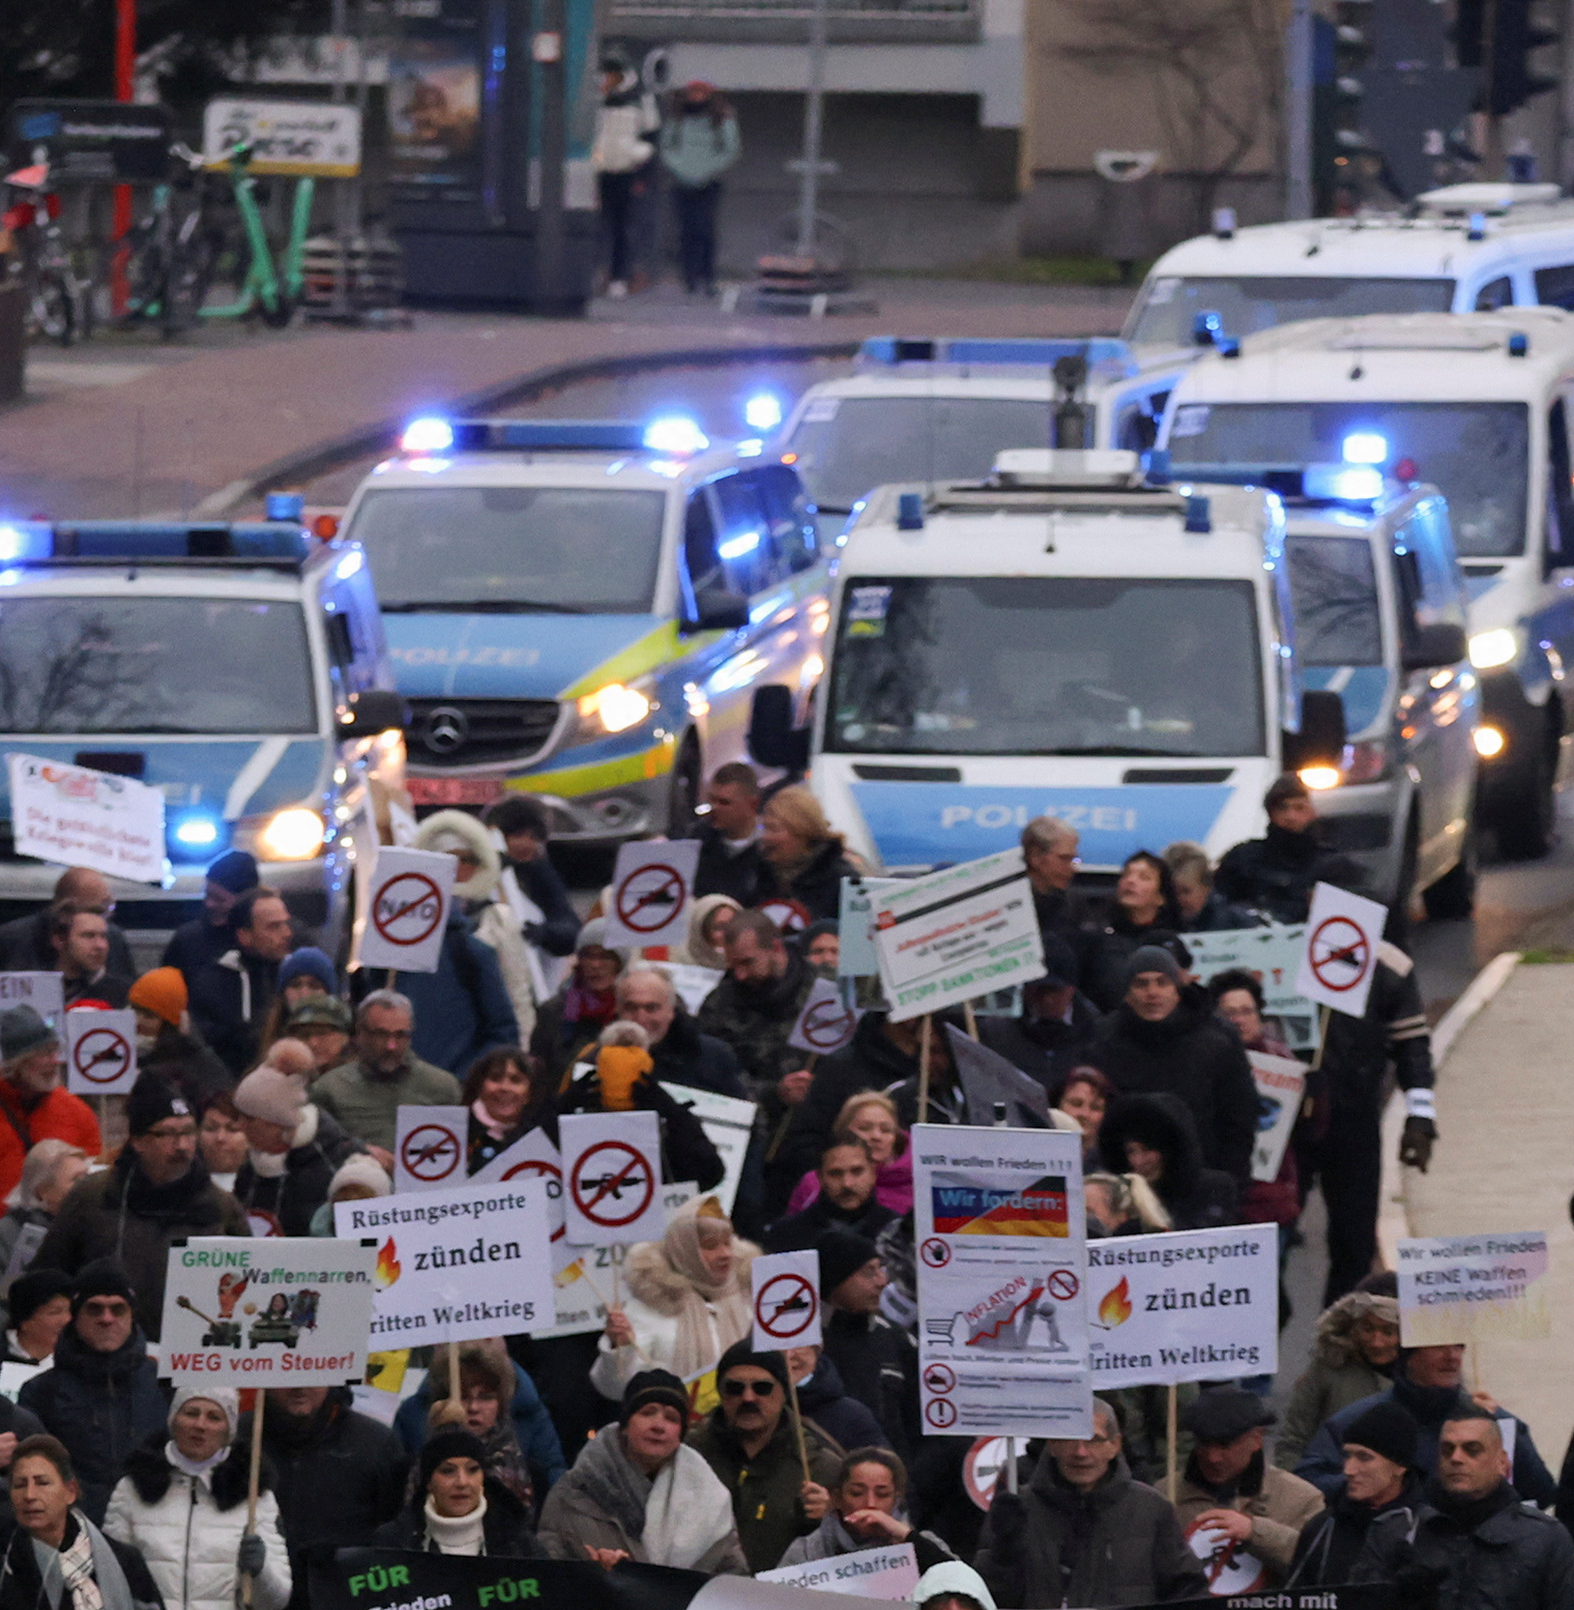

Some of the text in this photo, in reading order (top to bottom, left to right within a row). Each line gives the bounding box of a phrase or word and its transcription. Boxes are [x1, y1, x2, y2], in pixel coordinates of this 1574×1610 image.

[920, 1155, 947, 1166] WIR
[951, 1156, 994, 1168] wollen
[998, 1157, 1047, 1170] Frieden
[939, 1189, 1064, 1211] Wir fordern:
[352, 1194, 526, 1229] Rüstungsexporte
[414, 1238, 522, 1271] zünden
[1088, 1241, 1260, 1267] Rüstungsexporte
[1486, 1240, 1547, 1254] Frieden
[182, 1249, 251, 1268] GRÜNE
[243, 1268, 372, 1284] Waffennarren,
[1415, 1266, 1526, 1285] KEINE Waffen
[1145, 1283, 1252, 1311] zünden
[370, 1315, 427, 1334] ritten
[433, 1299, 535, 1326] Weltkrieg
[171, 1352, 355, 1372] WEG vom Steuer!
[1159, 1343, 1260, 1365] Weltkrieg
[835, 1554, 910, 1580] schaffen
[348, 1564, 410, 1597] FÜR
[477, 1578, 541, 1608] FÜR
[1227, 1592, 1338, 1610] mach mit
